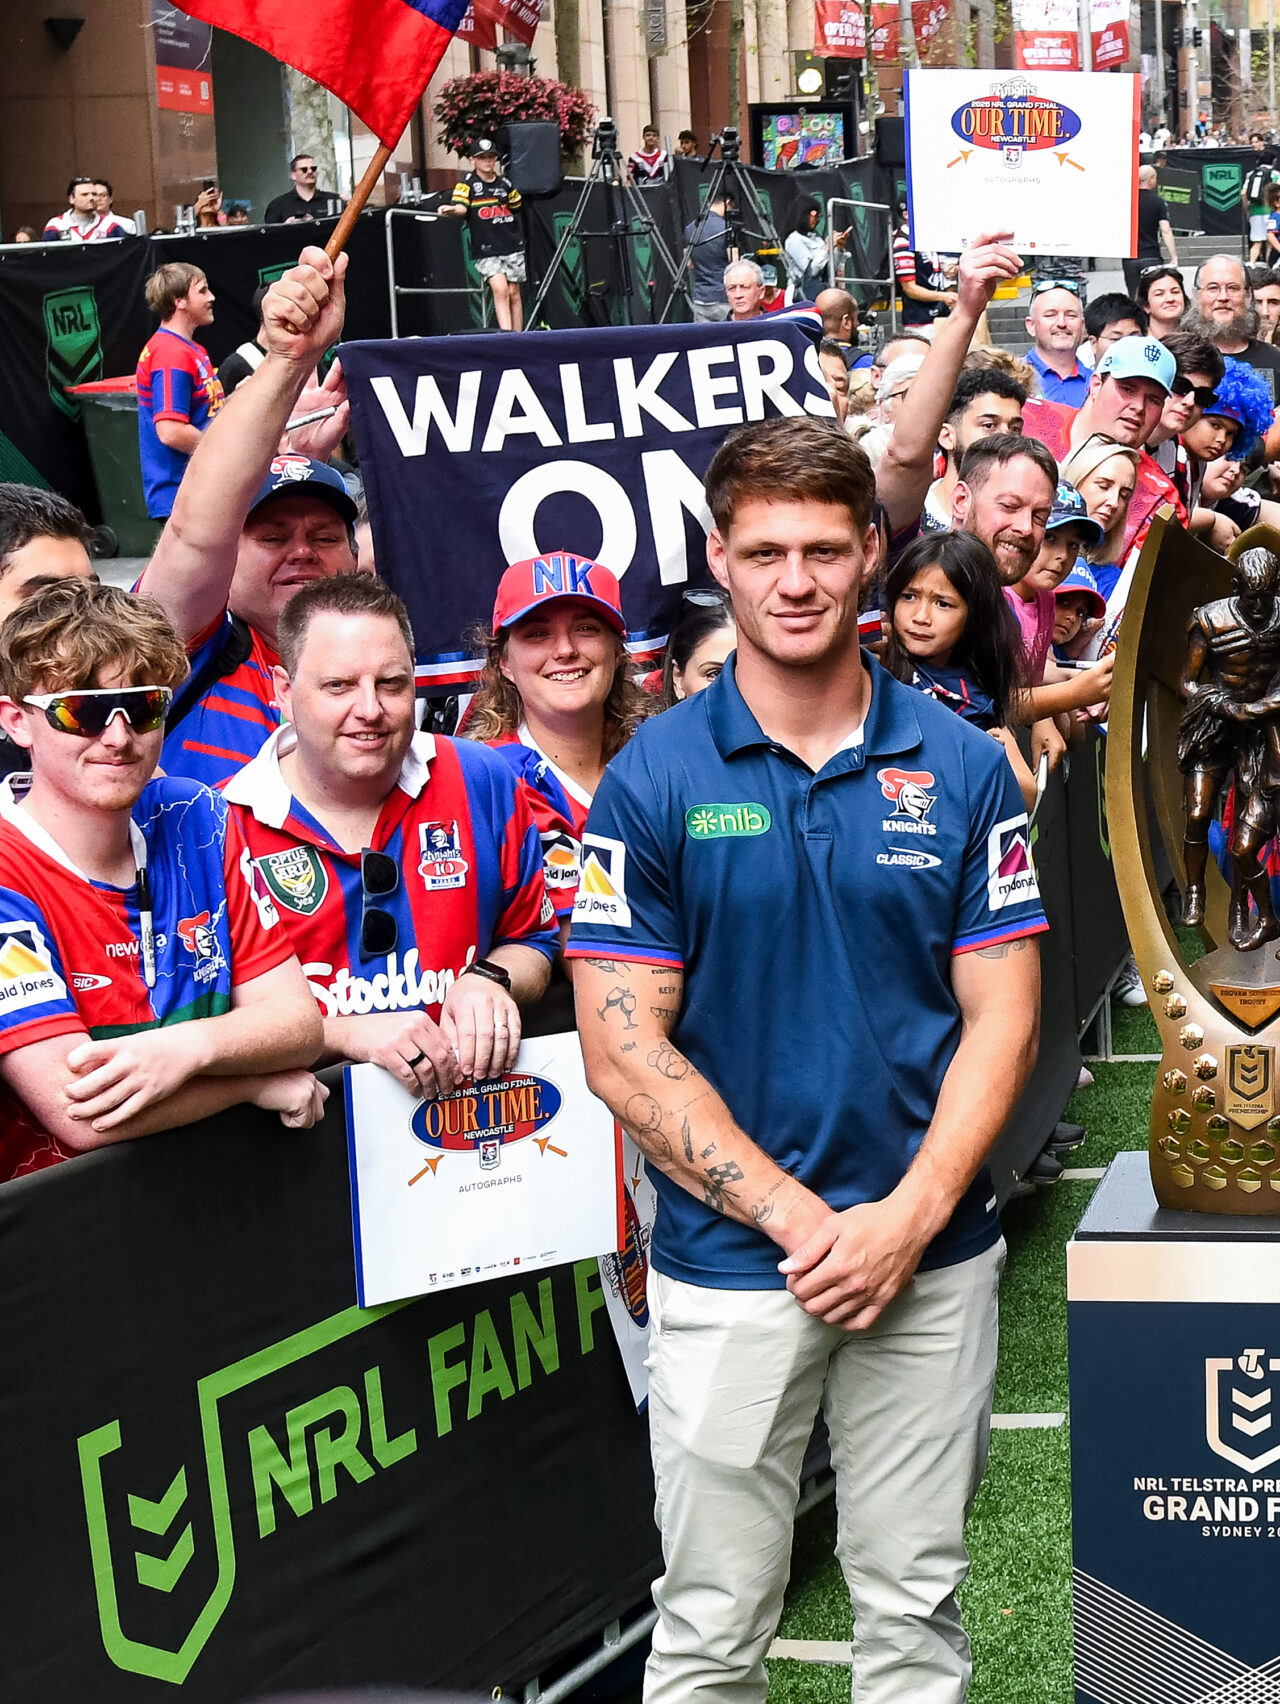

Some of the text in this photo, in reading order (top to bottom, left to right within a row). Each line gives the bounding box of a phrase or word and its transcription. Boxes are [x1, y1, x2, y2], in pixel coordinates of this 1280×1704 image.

[961, 108, 1005, 136] OUR
[1209, 170, 1236, 180] NRL
[51, 303, 92, 338] NRL
[532, 556, 595, 597] NK
[719, 807, 765, 832] nib
[882, 820, 937, 835] KNIGHTS
[268, 849, 308, 867] OPTUS
[876, 853, 926, 866] CLASSIC
[434, 861, 455, 876] 10
[20, 977, 54, 996] jones
[73, 977, 94, 988] SIC
[462, 1087, 480, 1098] NRL
[481, 1082, 510, 1094] GRAND
[510, 1078, 536, 1089] FINAL
[425, 1085, 550, 1138] OUR TIME.
[464, 1124, 515, 1140] NEWCASTLE
[458, 1175, 523, 1193] AUTOGRAPHS
[605, 1252, 620, 1298] Knigh
[248, 1366, 417, 1539] NRL
[428, 1277, 561, 1437] FAN
[1133, 1477, 1168, 1492] NRL
[1170, 1477, 1248, 1493] TELSTRA
[1142, 1495, 1259, 1523] GRAND
[1201, 1526, 1263, 1539] SYDNEY
